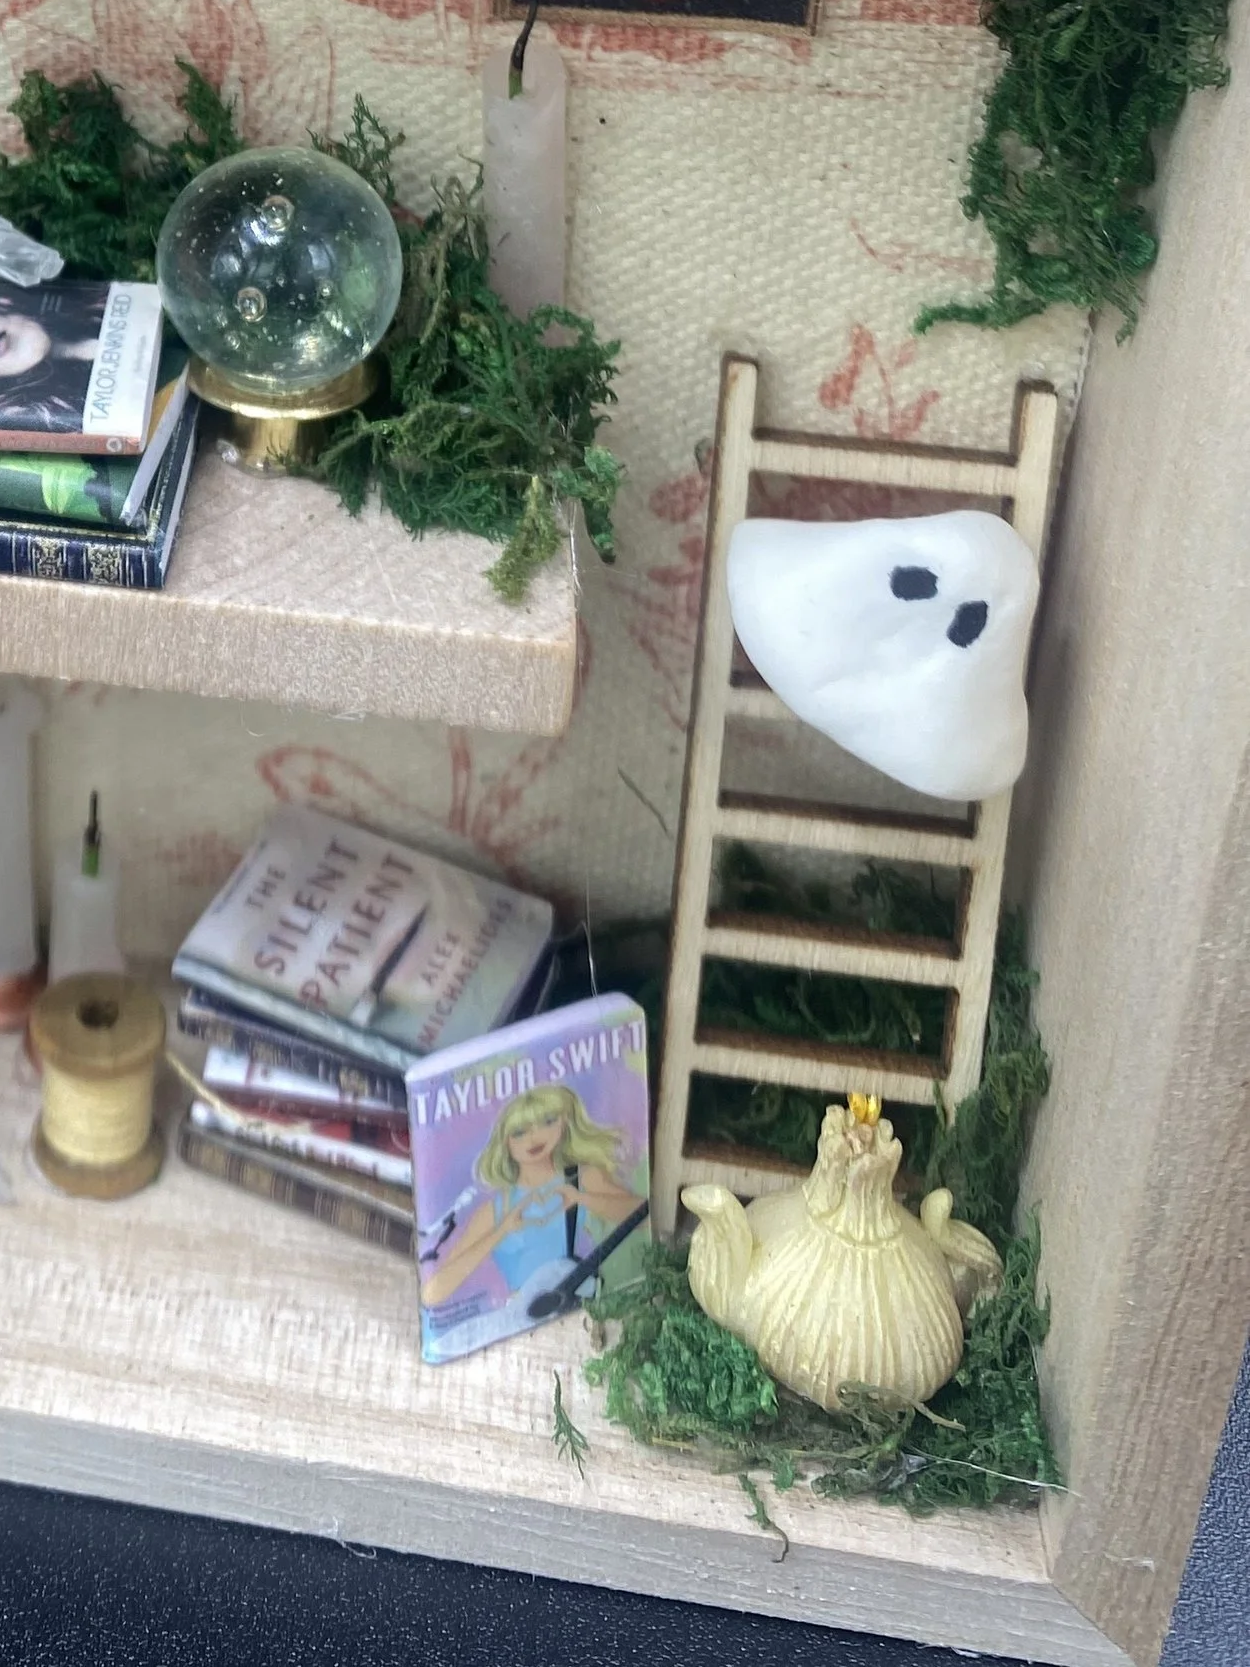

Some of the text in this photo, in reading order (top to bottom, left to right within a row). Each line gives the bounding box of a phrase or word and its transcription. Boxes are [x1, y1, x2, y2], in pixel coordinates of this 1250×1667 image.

[90, 367, 117, 424] TAYLOR
[245, 864, 286, 909] THE
[254, 836, 360, 976] SILENT
[298, 852, 414, 1010] PATIENT
[420, 931, 461, 986] ALEX
[413, 1019, 645, 1127] TAYLOR SWIFT
